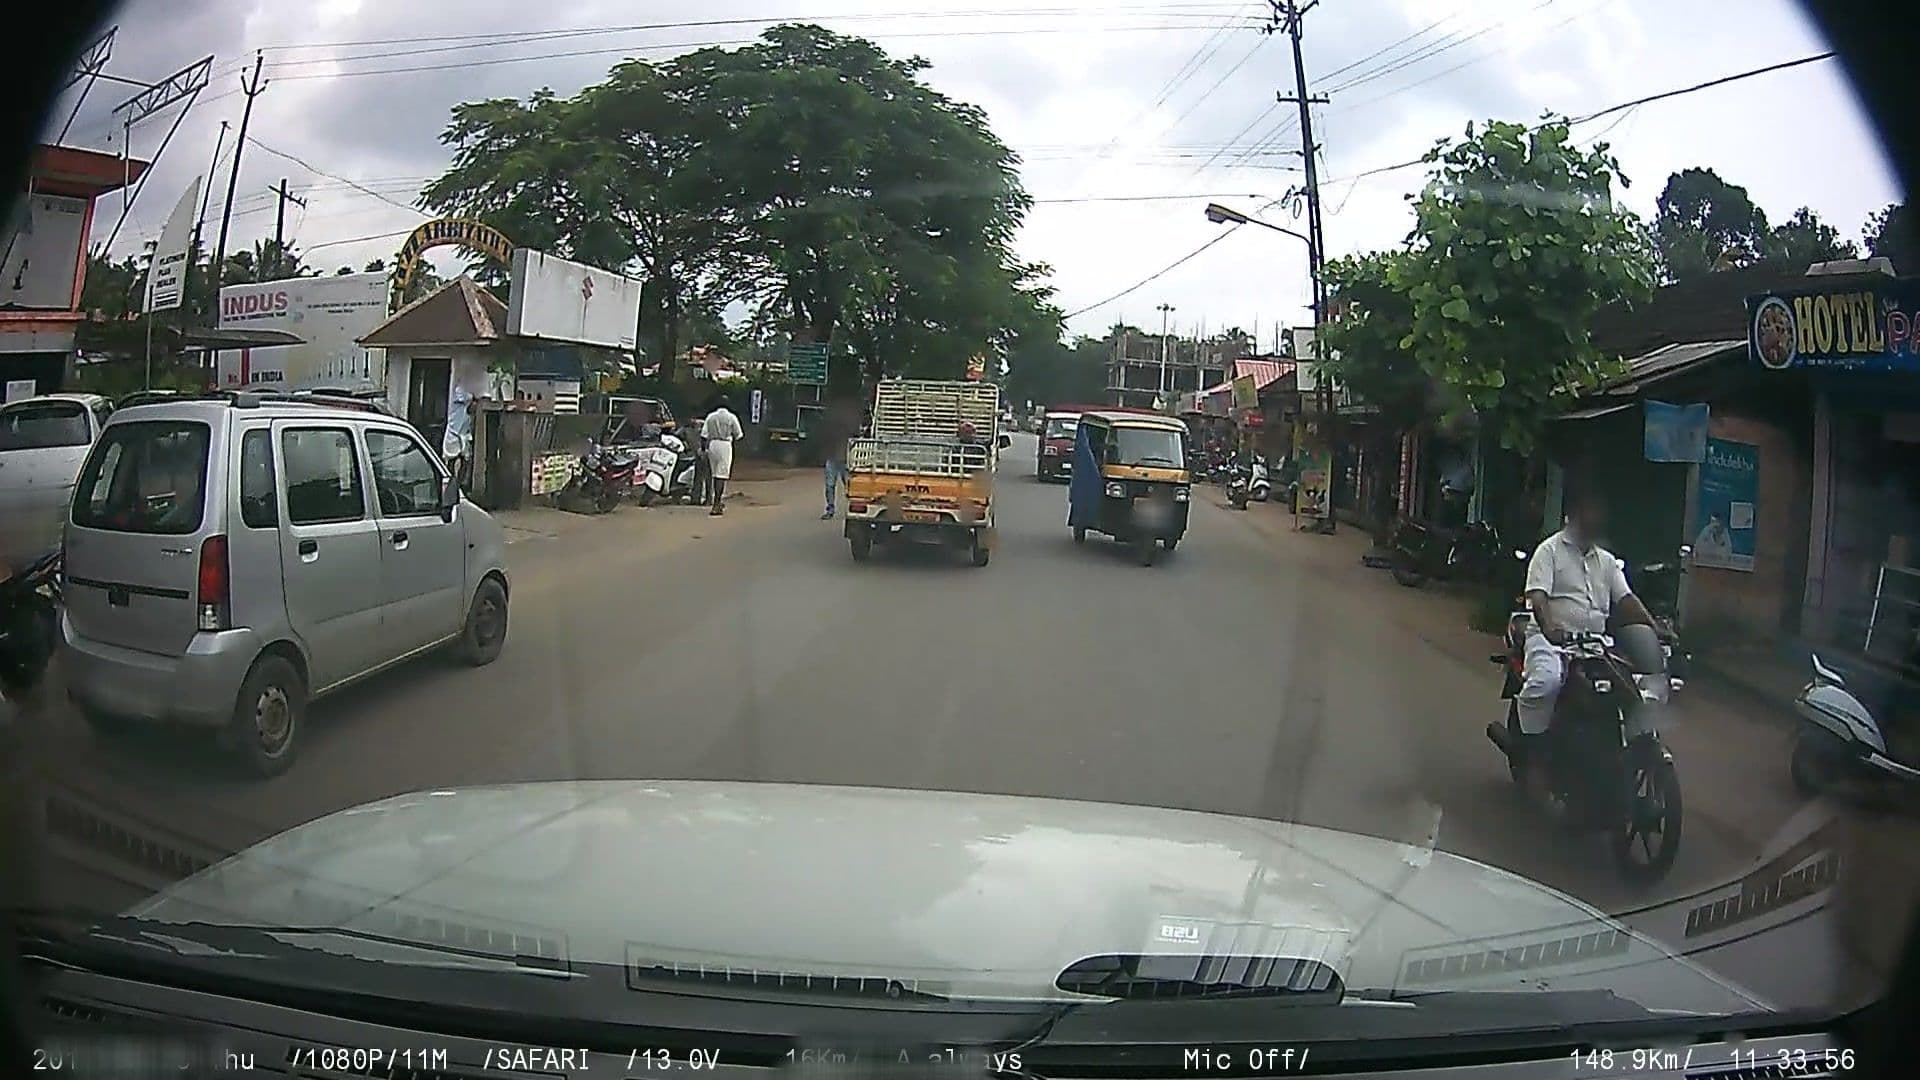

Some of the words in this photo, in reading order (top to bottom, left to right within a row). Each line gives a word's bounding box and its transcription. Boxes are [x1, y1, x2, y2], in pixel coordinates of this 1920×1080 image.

[223, 291, 288, 316] INDUS
[1794, 291, 1884, 354] HOTEL
[904, 485, 930, 494] TATA
